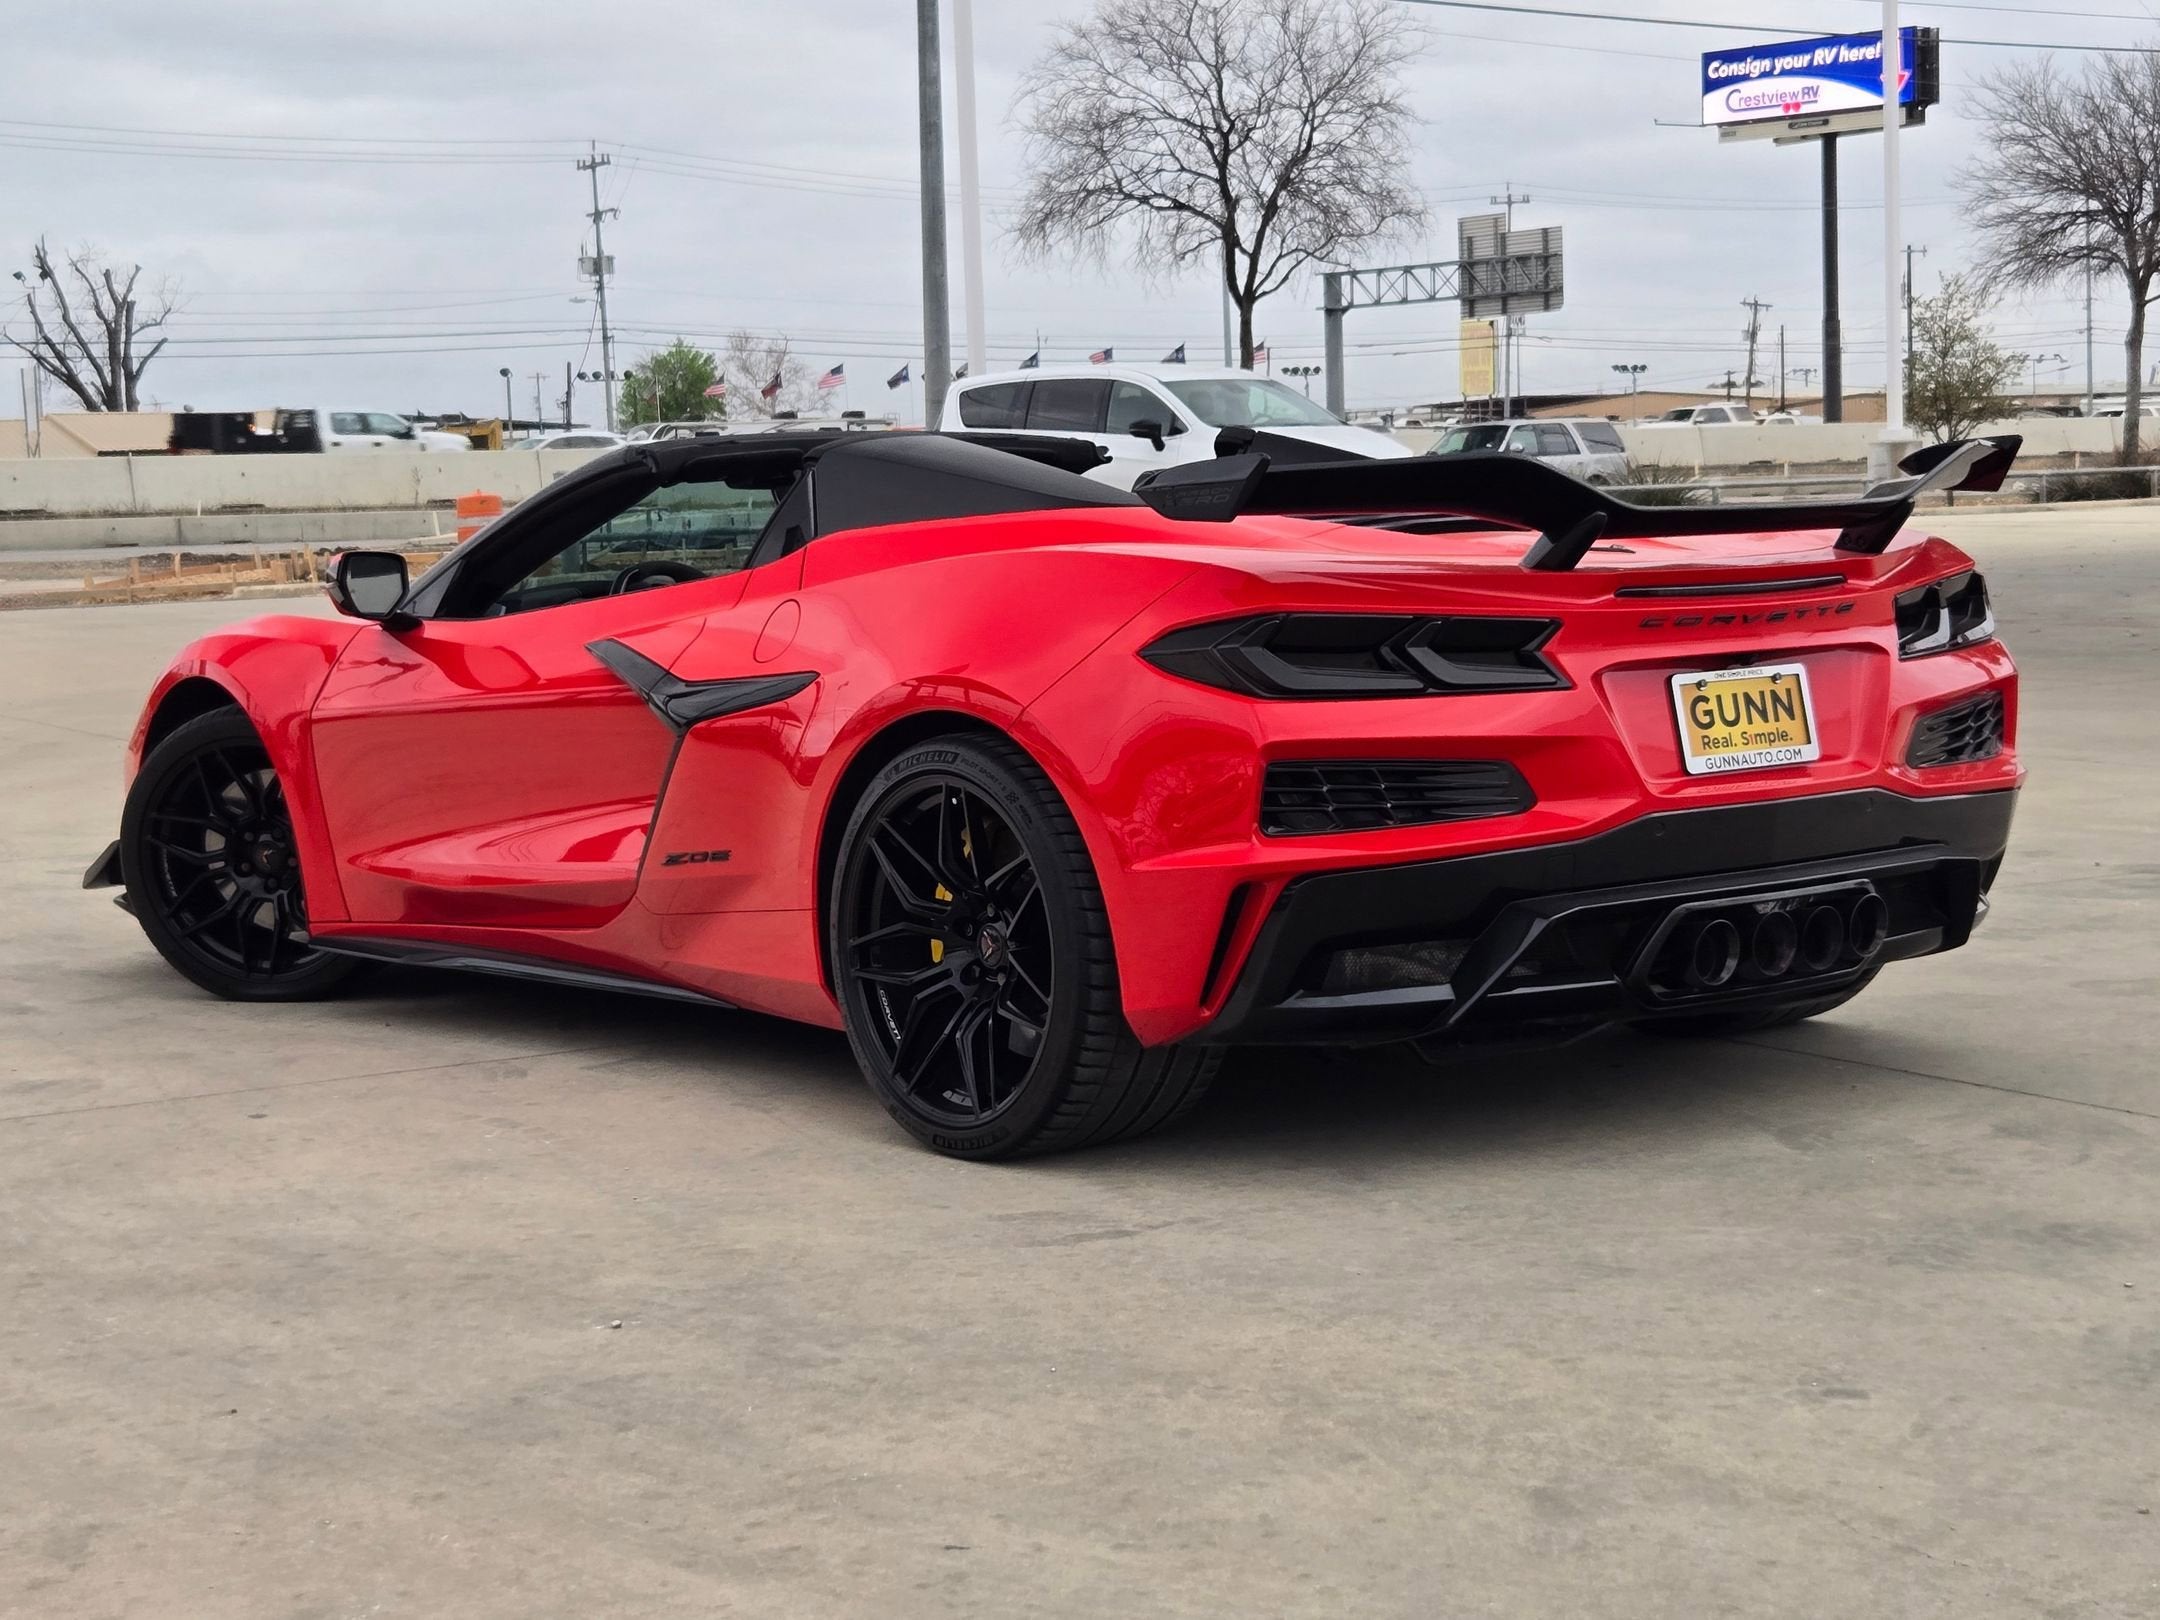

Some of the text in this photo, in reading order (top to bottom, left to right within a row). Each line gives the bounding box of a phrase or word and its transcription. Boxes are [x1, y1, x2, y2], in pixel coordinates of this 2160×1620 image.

[1708, 41, 1883, 80] Consign your RV here!
[1639, 602, 1856, 629] CORVETTE
[1689, 687, 1796, 731] GUNN
[1701, 727, 1793, 751] Real. Simple.
[899, 751, 956, 773] MICHELIN
[1705, 748, 1803, 770] GUNNAUTO.COM
